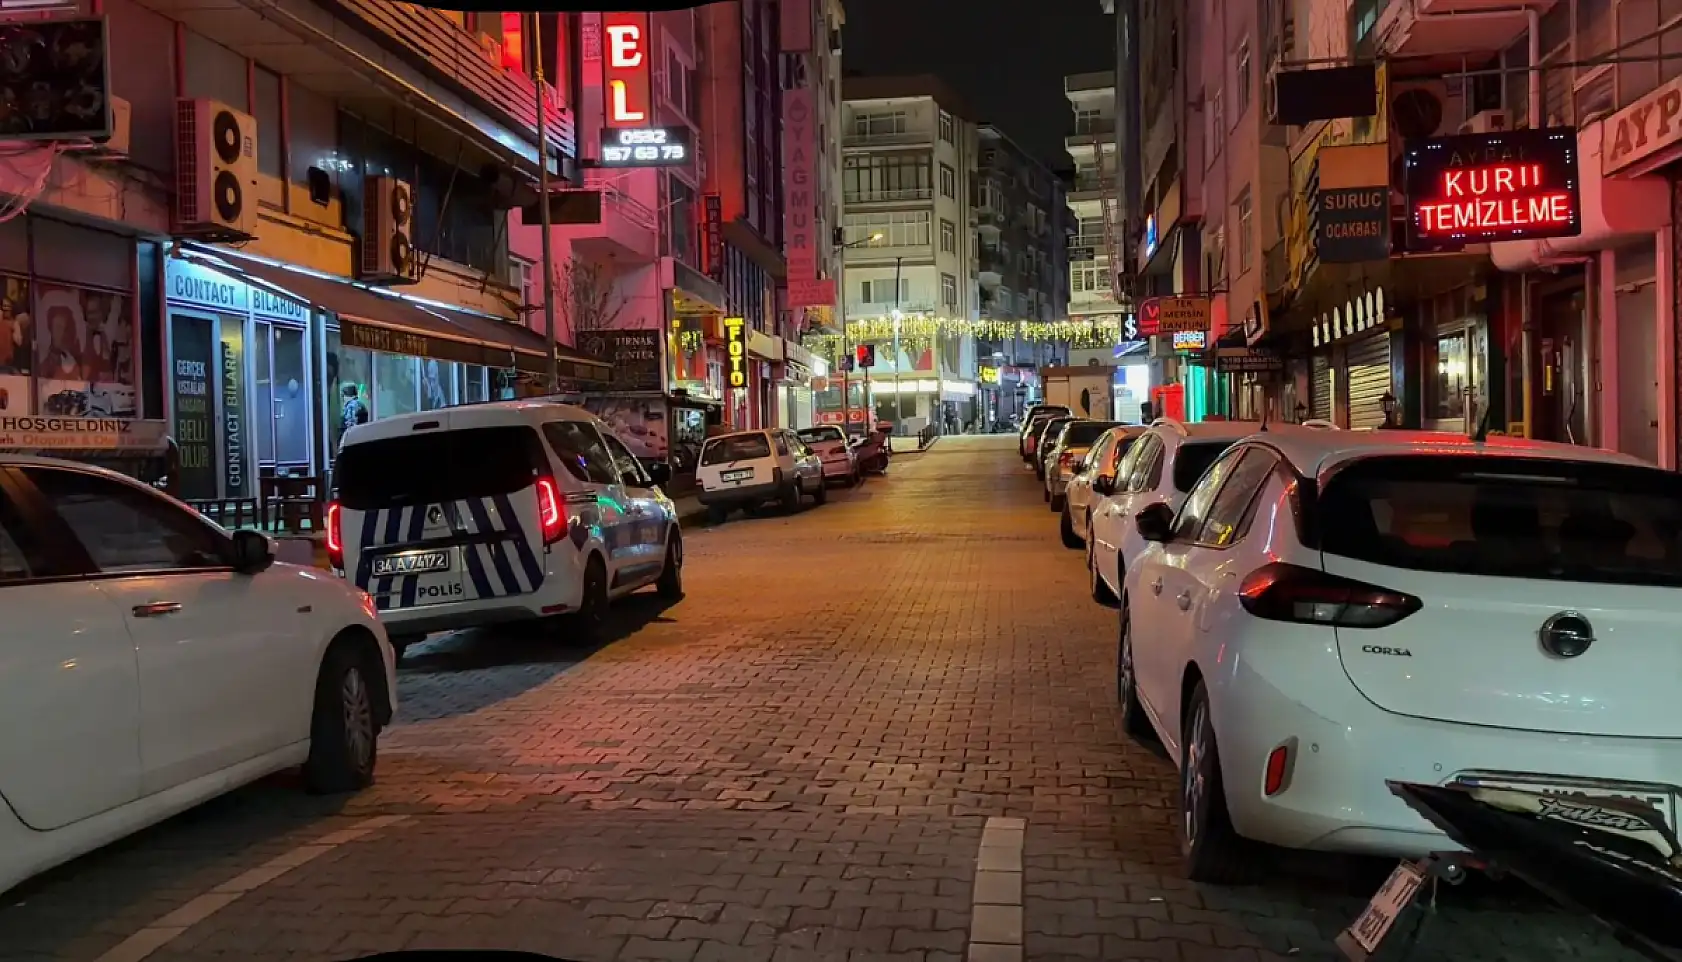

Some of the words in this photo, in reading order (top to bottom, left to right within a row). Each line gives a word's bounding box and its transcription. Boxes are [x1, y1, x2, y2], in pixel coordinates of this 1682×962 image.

[1419, 195, 1568, 231] TEMİZLEME
[175, 274, 236, 306] CONTACT
[729, 326, 743, 386] FOTO
[226, 411, 242, 487] CONTACT
[377, 559, 393, 573] 34
[396, 558, 406, 572] A
[418, 580, 462, 597] POLİS
[1362, 645, 1412, 656] CORSA
